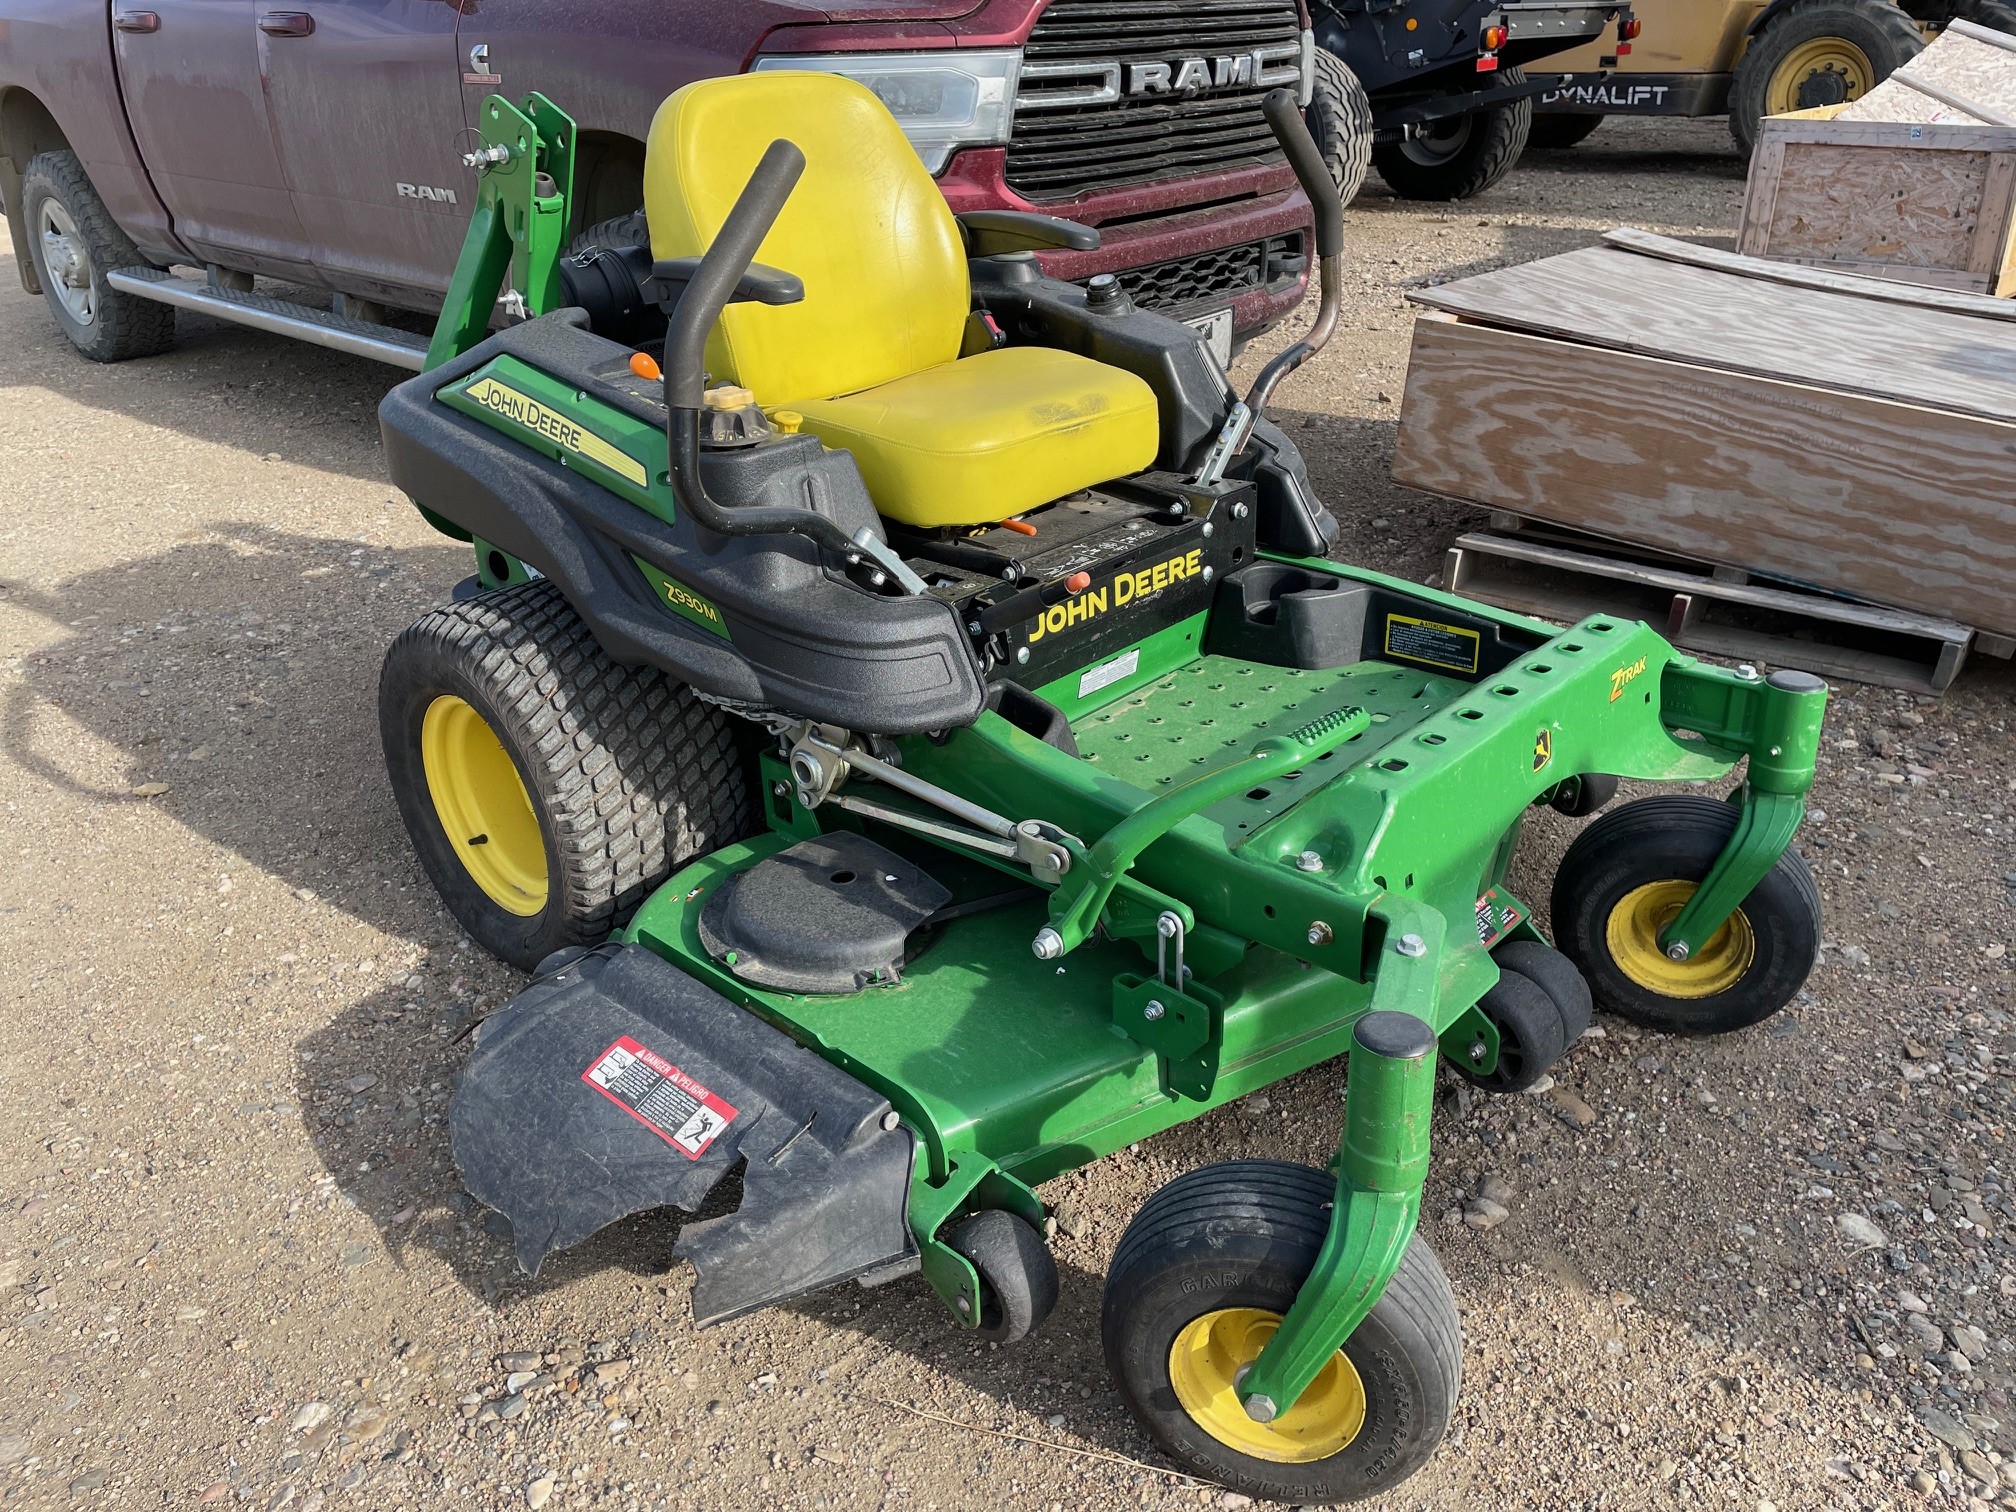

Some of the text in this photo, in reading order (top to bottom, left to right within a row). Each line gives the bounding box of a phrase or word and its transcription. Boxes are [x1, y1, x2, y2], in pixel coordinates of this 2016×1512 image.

[1130, 56, 1252, 95] RAM
[1542, 85, 1669, 105] DYNALIFT
[396, 182, 457, 204] RAM
[481, 382, 581, 450] JOHN DEERE
[663, 581, 718, 623] Z930M
[1029, 586, 1108, 643] JOHN
[1114, 548, 1201, 607] DEERE
[643, 1051, 672, 1075] DANGER
[677, 1076, 709, 1101] PELIGRO
